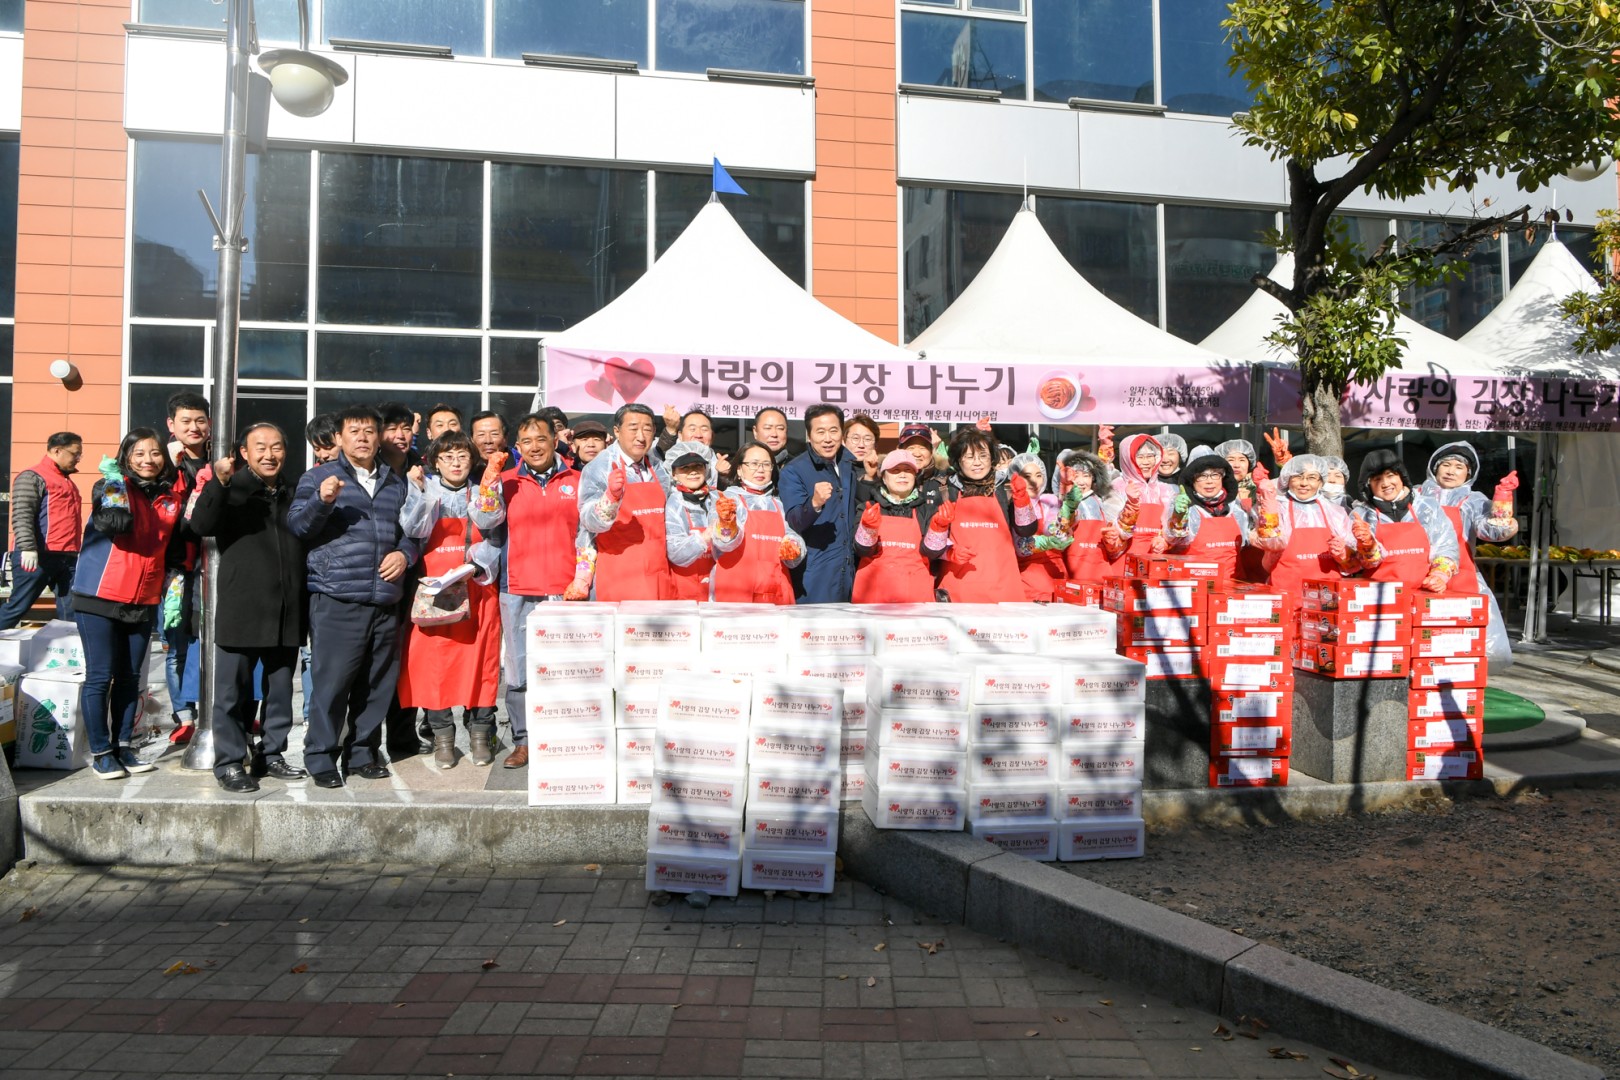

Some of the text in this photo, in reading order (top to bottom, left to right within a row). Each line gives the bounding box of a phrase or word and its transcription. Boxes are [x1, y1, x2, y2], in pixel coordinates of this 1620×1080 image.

[673, 358, 1016, 406] 사랑의 김장 나누기
[1129, 386, 1146, 396] 일자:
[1368, 375, 1456, 416] 사랑의
[1471, 379, 1531, 417] 김장
[1128, 397, 1146, 407] 장소:
[883, 409, 922, 420] 해운대점,
[925, 409, 951, 421] 해운대
[1377, 416, 1394, 426] 주최:
[993, 682, 1041, 690] 사랑의 김장 나누기
[1083, 681, 1099, 689] 사랑의
[1113, 680, 1130, 688] 나누기
[901, 688, 917, 696] 사랑의
[933, 689, 950, 697] 나누기
[791, 702, 803, 710] 김장
[805, 703, 823, 711] 나누기
[989, 721, 1006, 729] 사랑의
[1022, 720, 1039, 728] 나누기
[1078, 720, 1126, 729] 사랑의 김장 나누기
[900, 728, 951, 737] 사랑의 김장 나누기
[764, 742, 815, 752] 사랑의 김장 나누기
[693, 748, 705, 756] 김장
[707, 749, 725, 757] 나누기
[990, 760, 1007, 768] 사랑의
[1022, 759, 1039, 767] 나누기
[1079, 761, 1095, 769] 사랑의
[1109, 760, 1126, 768] 나누기
[917, 767, 929, 775] 김장
[930, 767, 947, 776] 나누기
[704, 789, 722, 797] 나누기
[768, 786, 820, 795] 사랑의 김장 나누기
[989, 800, 1037, 809] 사랑의 김장 나누기
[1077, 800, 1093, 808] 사랑의
[897, 808, 947, 816] 사랑의 김장 나누기
[667, 829, 720, 839] 사랑의 김장 나누기
[765, 827, 817, 837] 사랑의 김장 나누기
[1010, 838, 1022, 847] 김장
[1023, 838, 1040, 846] 나누기
[1080, 836, 1129, 846] 사랑의 김장 나누기
[699, 872, 718, 881] 나누기
[762, 868, 814, 878] 사랑의 김장 나누기
